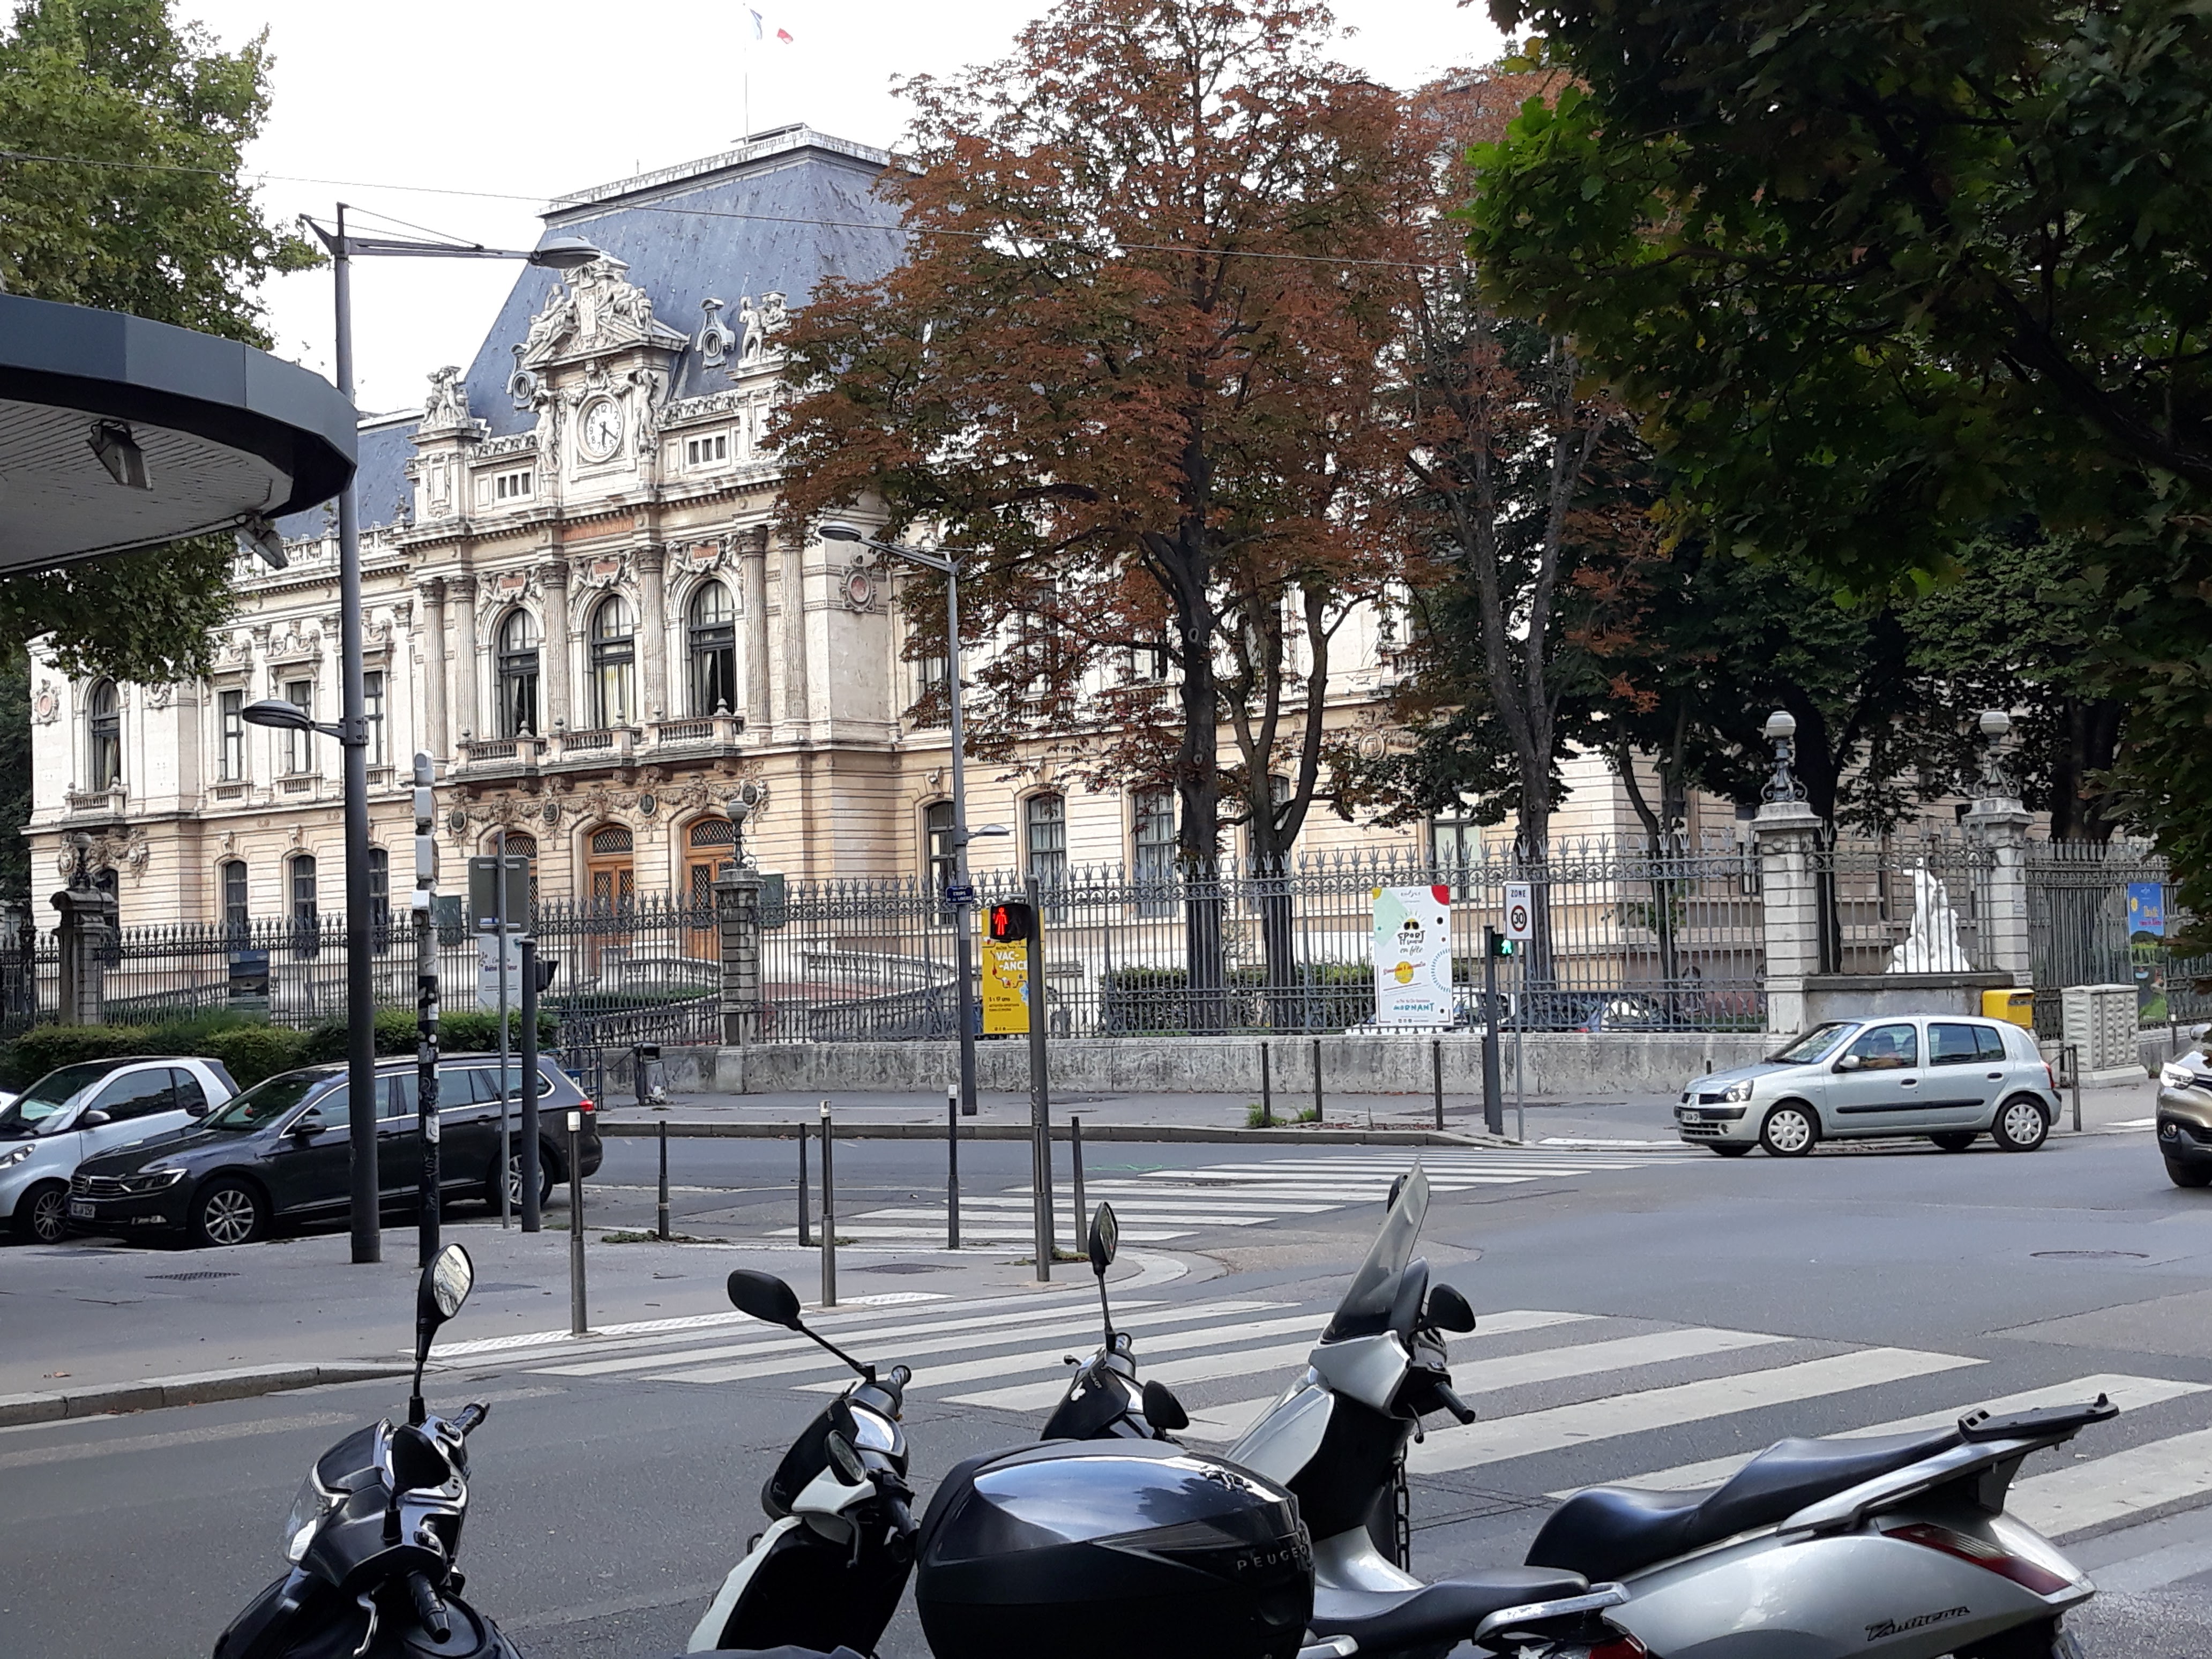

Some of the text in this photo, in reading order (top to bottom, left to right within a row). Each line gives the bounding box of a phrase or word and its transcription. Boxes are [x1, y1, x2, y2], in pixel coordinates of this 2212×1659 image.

[601, 405, 607, 413] 12
[614, 410, 618, 419] 2
[589, 427, 593, 435] 9
[591, 436, 596, 444] 8
[1511, 889, 1526, 898] ZONE
[1514, 913, 1524, 924] 30
[996, 951, 1020, 961] VAC-
